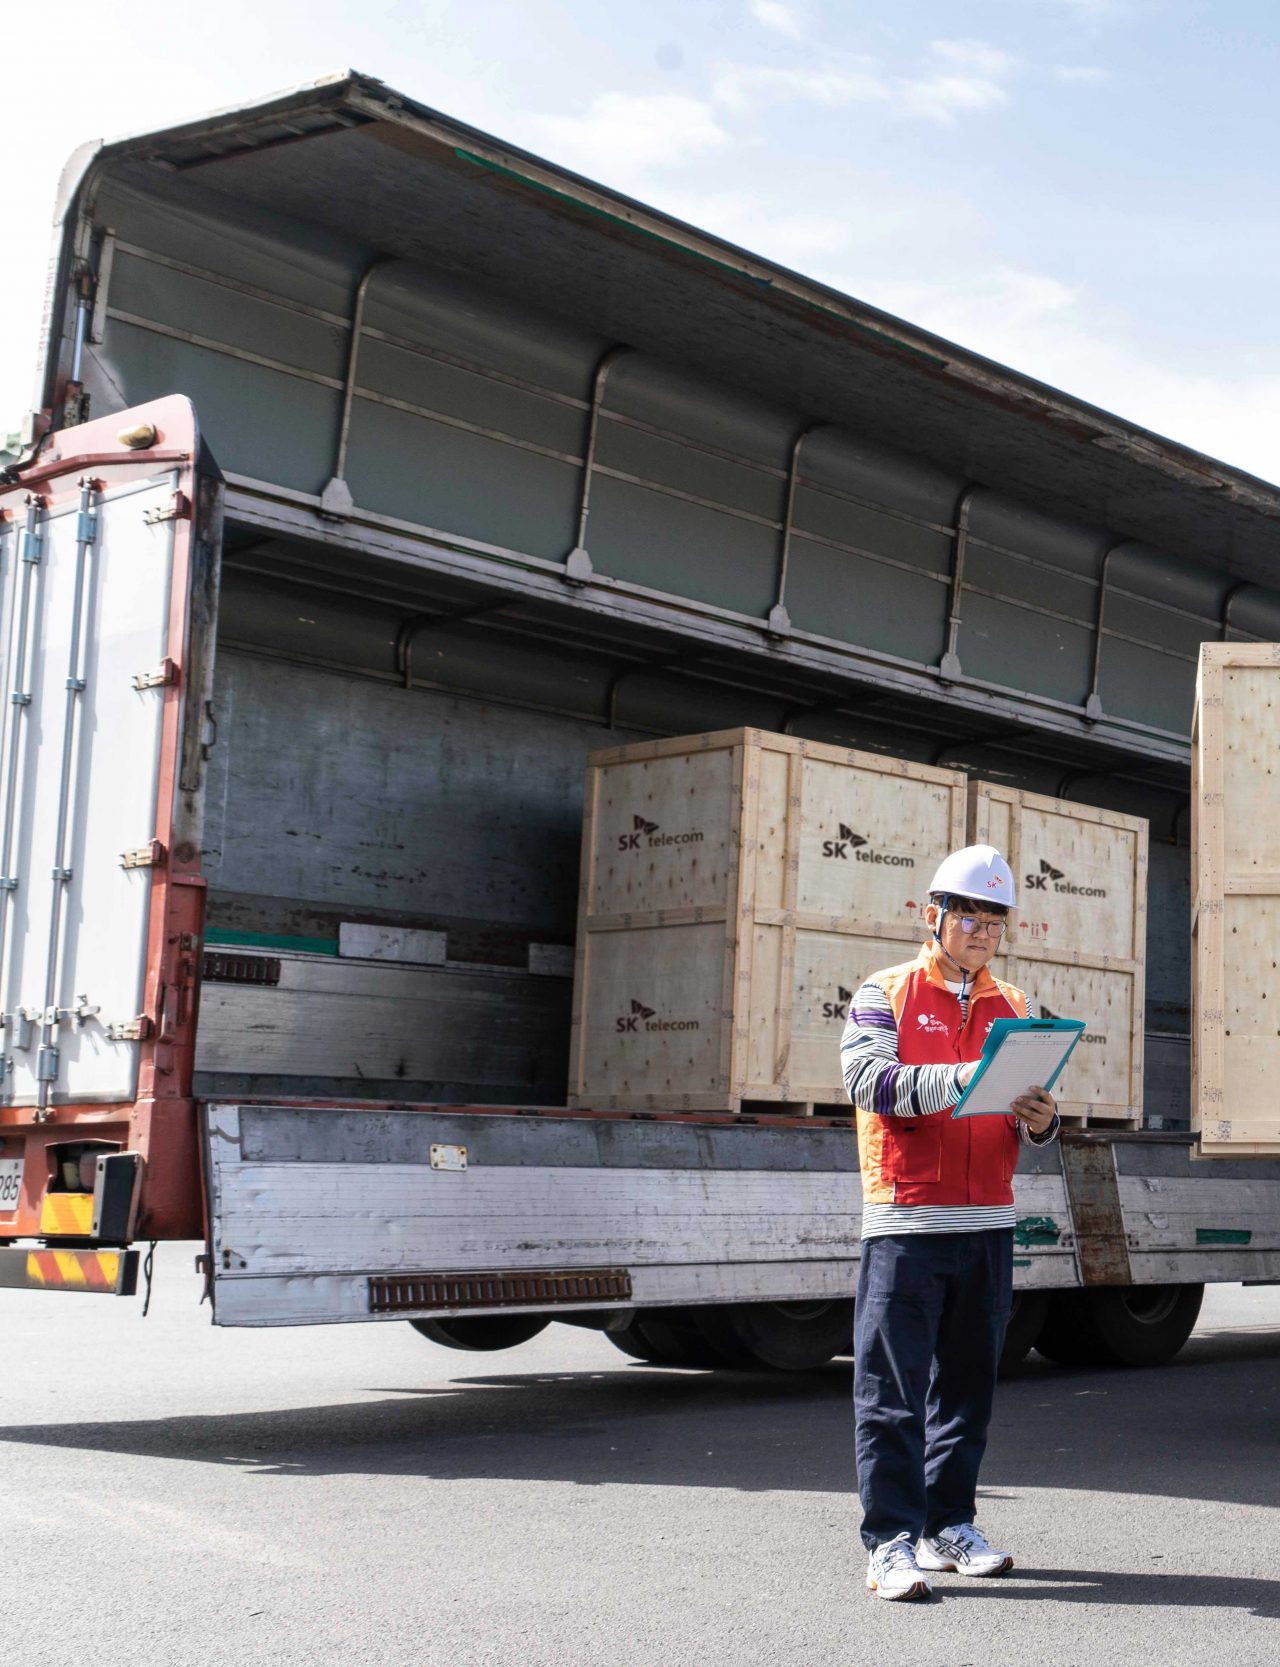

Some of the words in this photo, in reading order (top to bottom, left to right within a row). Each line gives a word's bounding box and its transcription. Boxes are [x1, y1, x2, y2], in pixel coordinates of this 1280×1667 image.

[618, 833, 641, 851] SK
[648, 831, 704, 847] telecom
[822, 840, 848, 860] SK
[855, 849, 915, 868] telecom
[1025, 874, 1047, 891] SK
[1054, 882, 1107, 898] telecom
[822, 1002, 846, 1020] SK
[616, 1017, 638, 1033] SK
[645, 1019, 699, 1031] telecom
